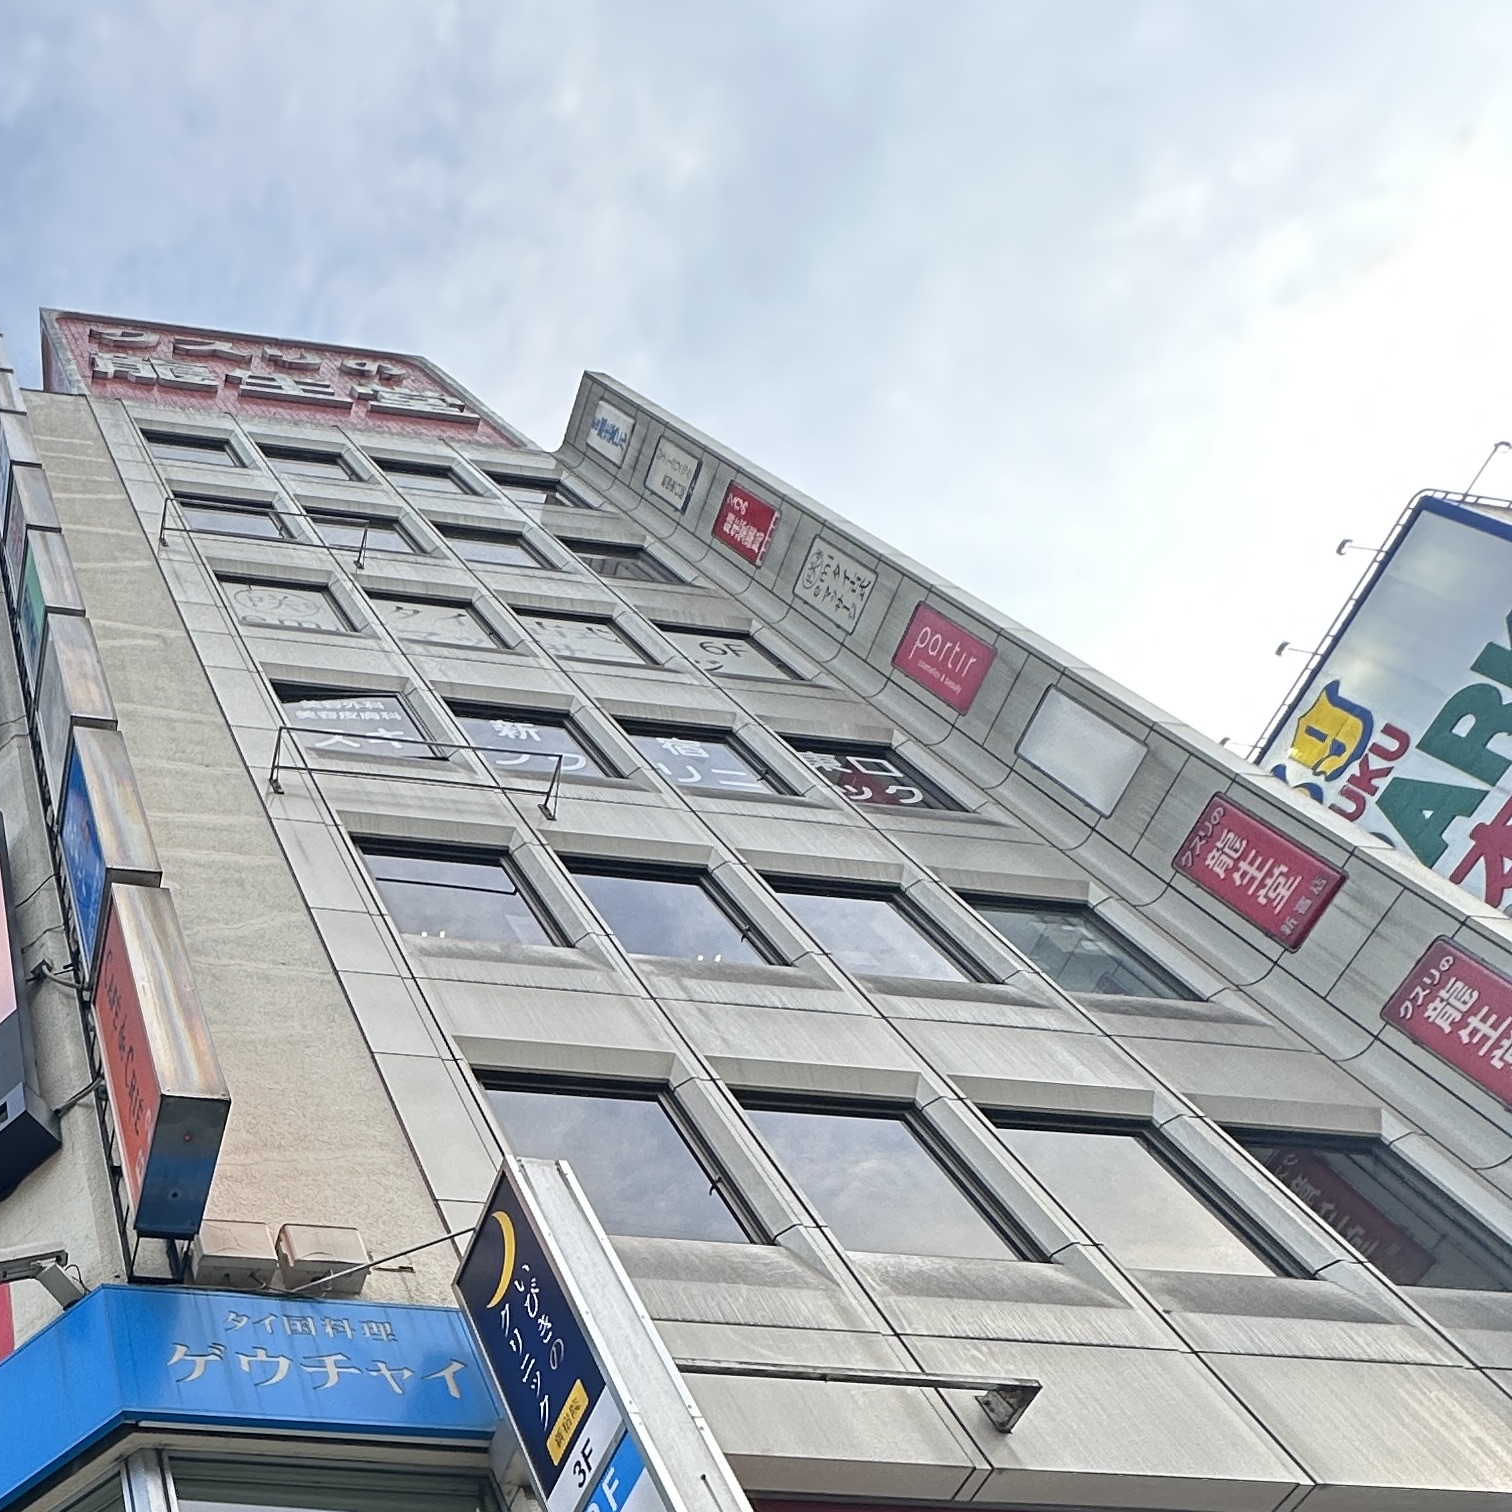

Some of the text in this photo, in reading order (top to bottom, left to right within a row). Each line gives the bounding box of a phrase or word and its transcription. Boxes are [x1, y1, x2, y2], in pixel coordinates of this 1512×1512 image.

[89, 328, 406, 380] クスリの
[909, 627, 977, 677] partir
[1181, 807, 1225, 868] クスリの
[1204, 829, 1302, 916] 龍生堂
[1399, 955, 1454, 1020] クスリの
[223, 1310, 398, 1342] タイ国料理
[514, 1263, 565, 1370] いびきの
[167, 1342, 468, 1400] ゲウチャイ
[500, 1302, 551, 1431] クリニック
[572, 1437, 595, 1489] 3F
